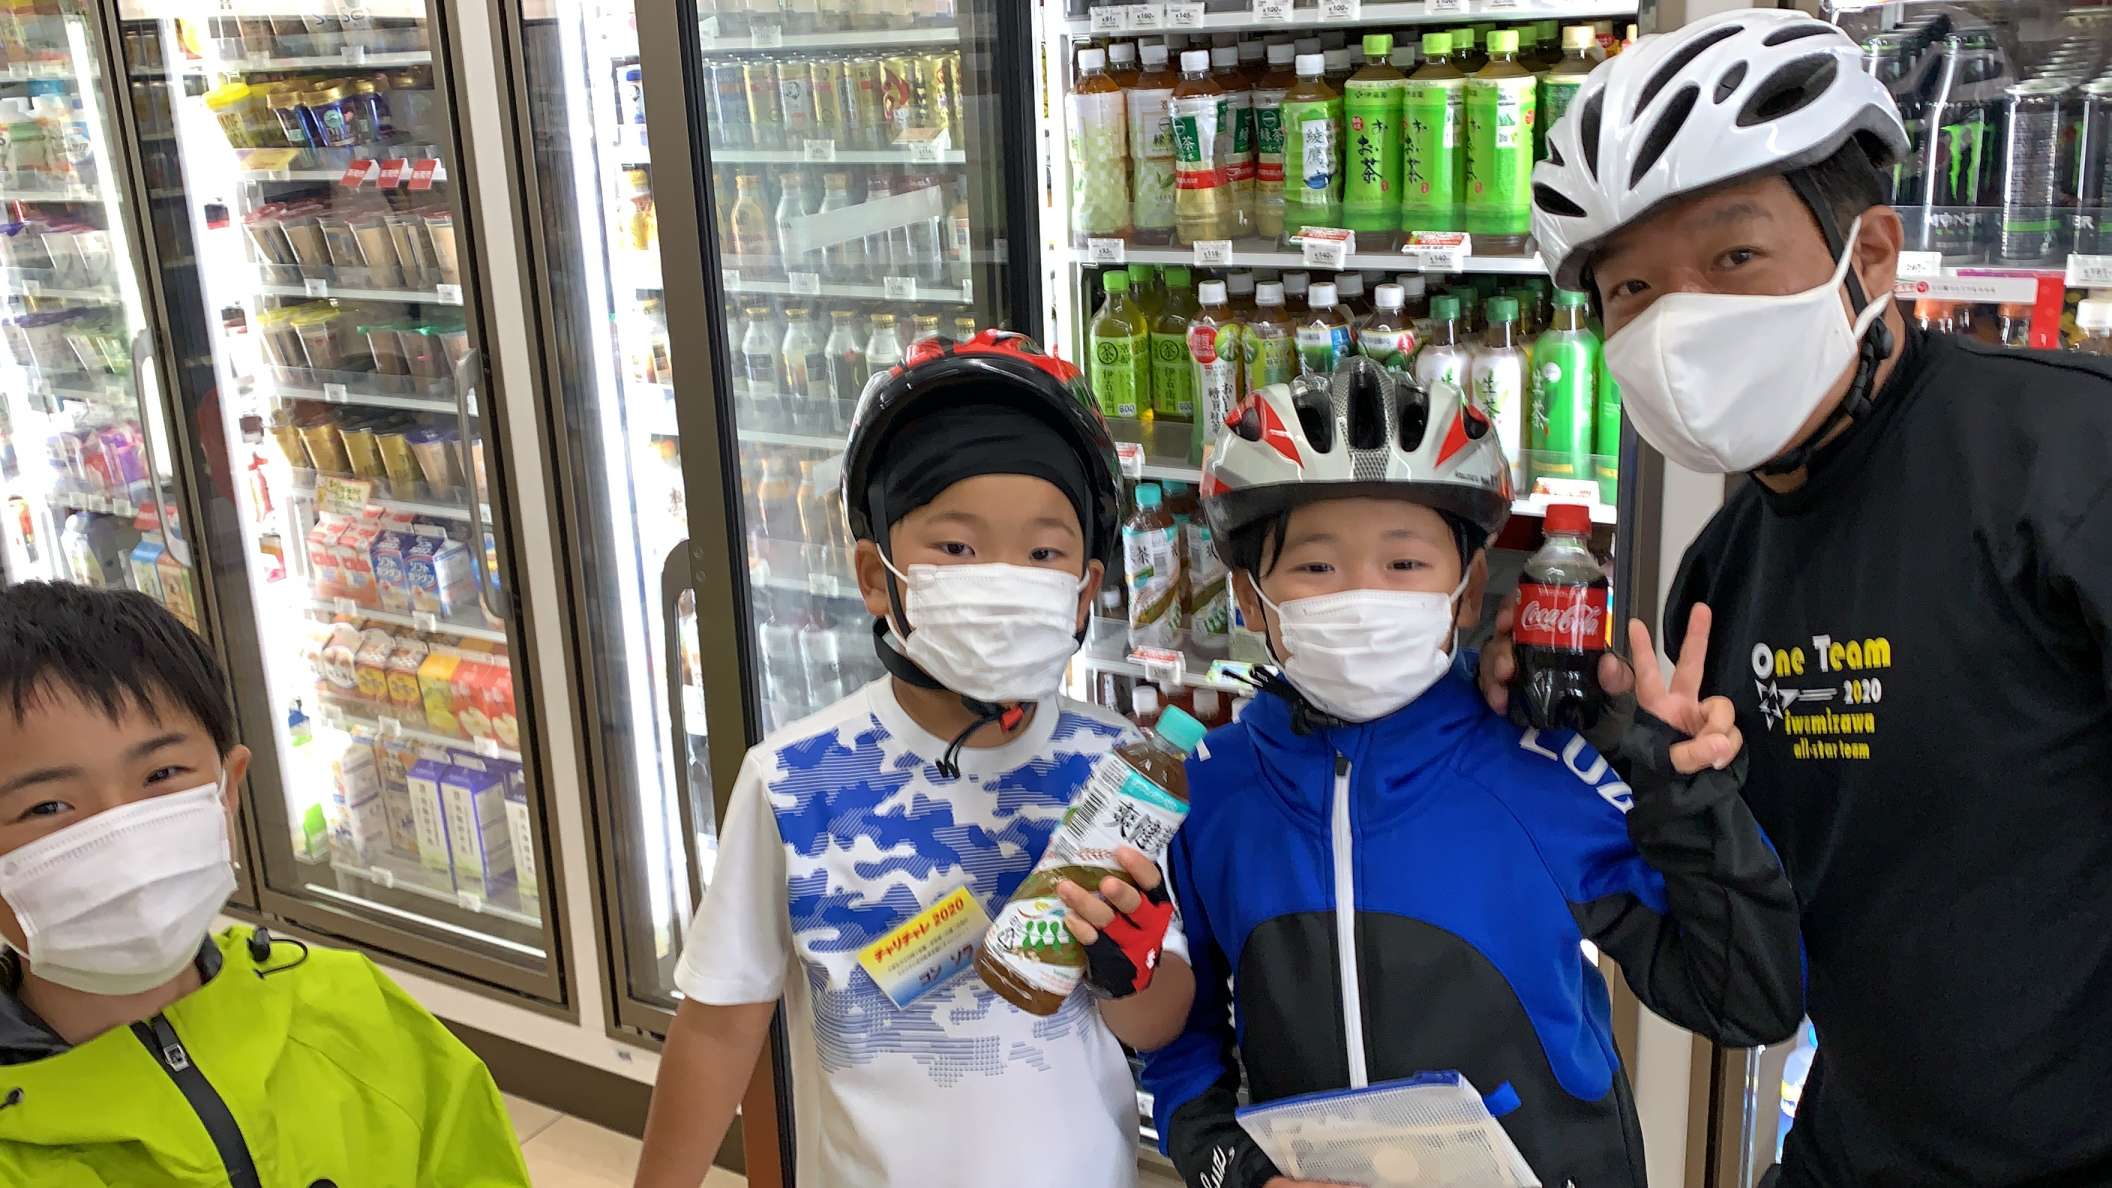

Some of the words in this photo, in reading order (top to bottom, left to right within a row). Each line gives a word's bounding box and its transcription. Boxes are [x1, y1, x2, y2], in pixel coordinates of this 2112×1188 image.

[1521, 600, 1602, 636] Coca-Cola
[1752, 642, 1806, 680] One
[1812, 634, 1891, 673] Team
[1843, 677, 1882, 705] 2020
[932, 894, 965, 928] 2020
